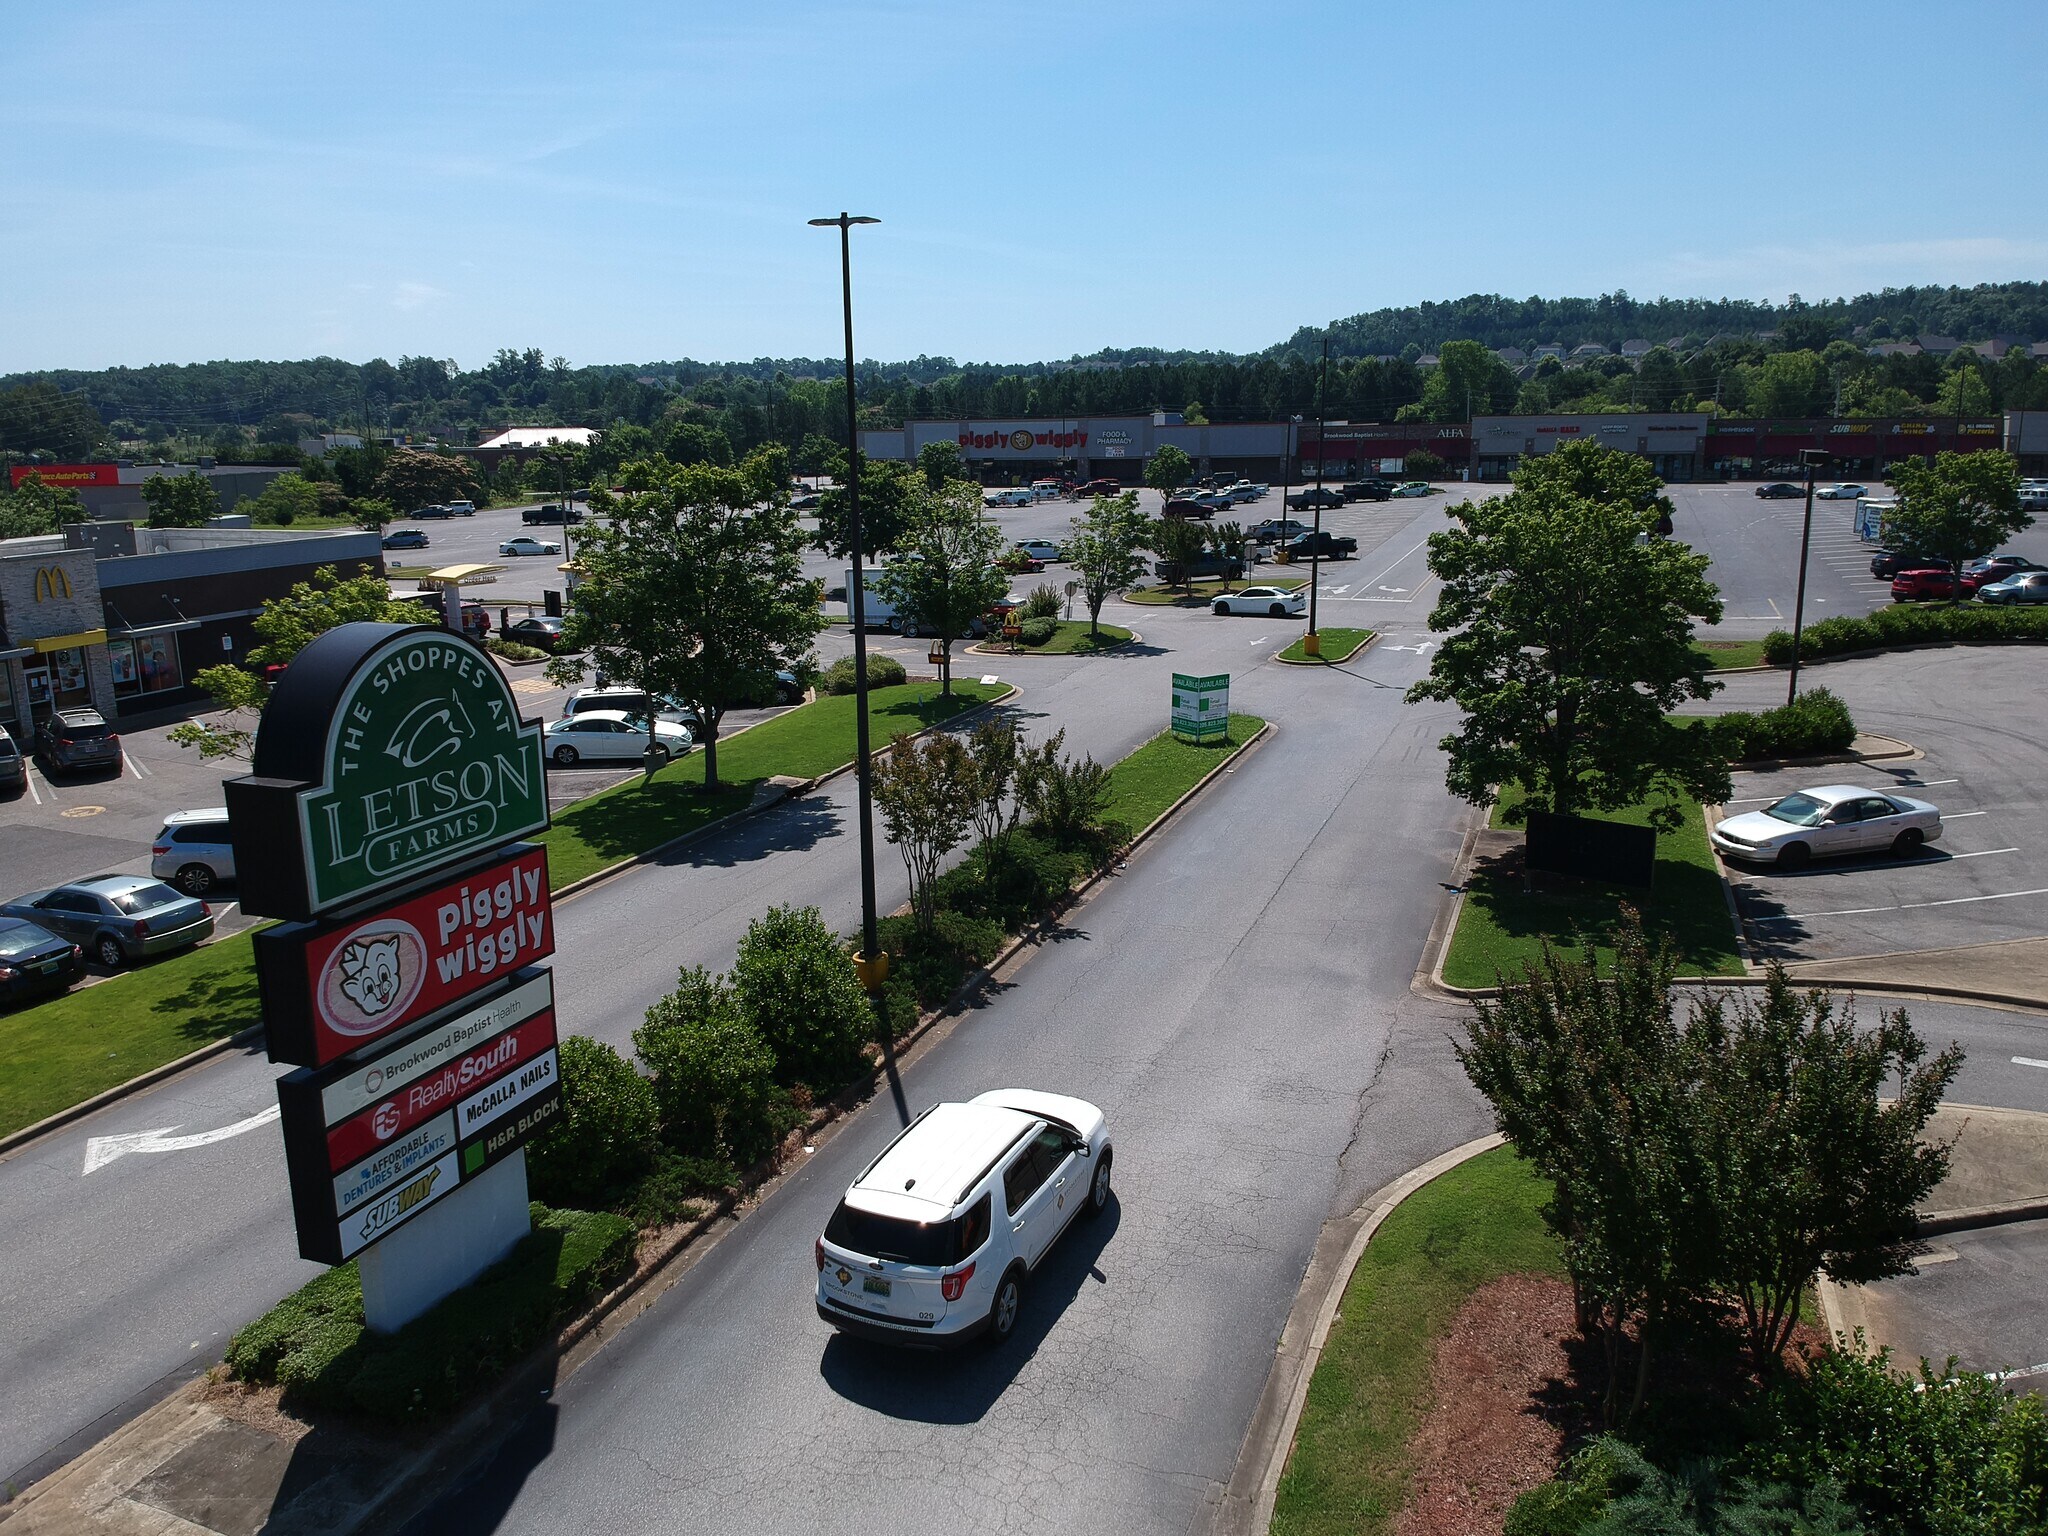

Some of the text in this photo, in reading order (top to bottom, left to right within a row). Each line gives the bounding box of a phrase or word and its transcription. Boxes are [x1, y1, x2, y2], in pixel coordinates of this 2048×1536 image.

[958, 429, 1088, 449] piggly wiggly
[1097, 437, 1133, 445] PHARMACY
[1437, 428, 1464, 438] ALFA
[1830, 424, 1872, 433] SUBWAY
[55, 472, 71, 480] Auto
[71, 472, 89, 480] Parts
[1172, 677, 1199, 689] AVAILABLE
[1199, 678, 1229, 688] AVAILABLE
[341, 647, 511, 776] THE SHOPPES AT
[322, 745, 530, 867] LETSON
[388, 813, 479, 862] FARMS
[437, 865, 541, 947] piggly
[436, 910, 545, 984] wiggly
[386, 1000, 521, 1080] Brookwood Baptist Health
[408, 1034, 518, 1115] RealtySouth
[466, 1060, 551, 1124] McCALLA NAILS
[488, 1096, 559, 1154] H&R BLOCK
[343, 1135, 445, 1205] DENTURES & IMPLANTS
[371, 1131, 429, 1176] AFFORDABLE
[360, 1164, 442, 1241] SUBWAY
[825, 1281, 864, 1300] BROOKSTONE
[919, 1311, 934, 1320] 029
